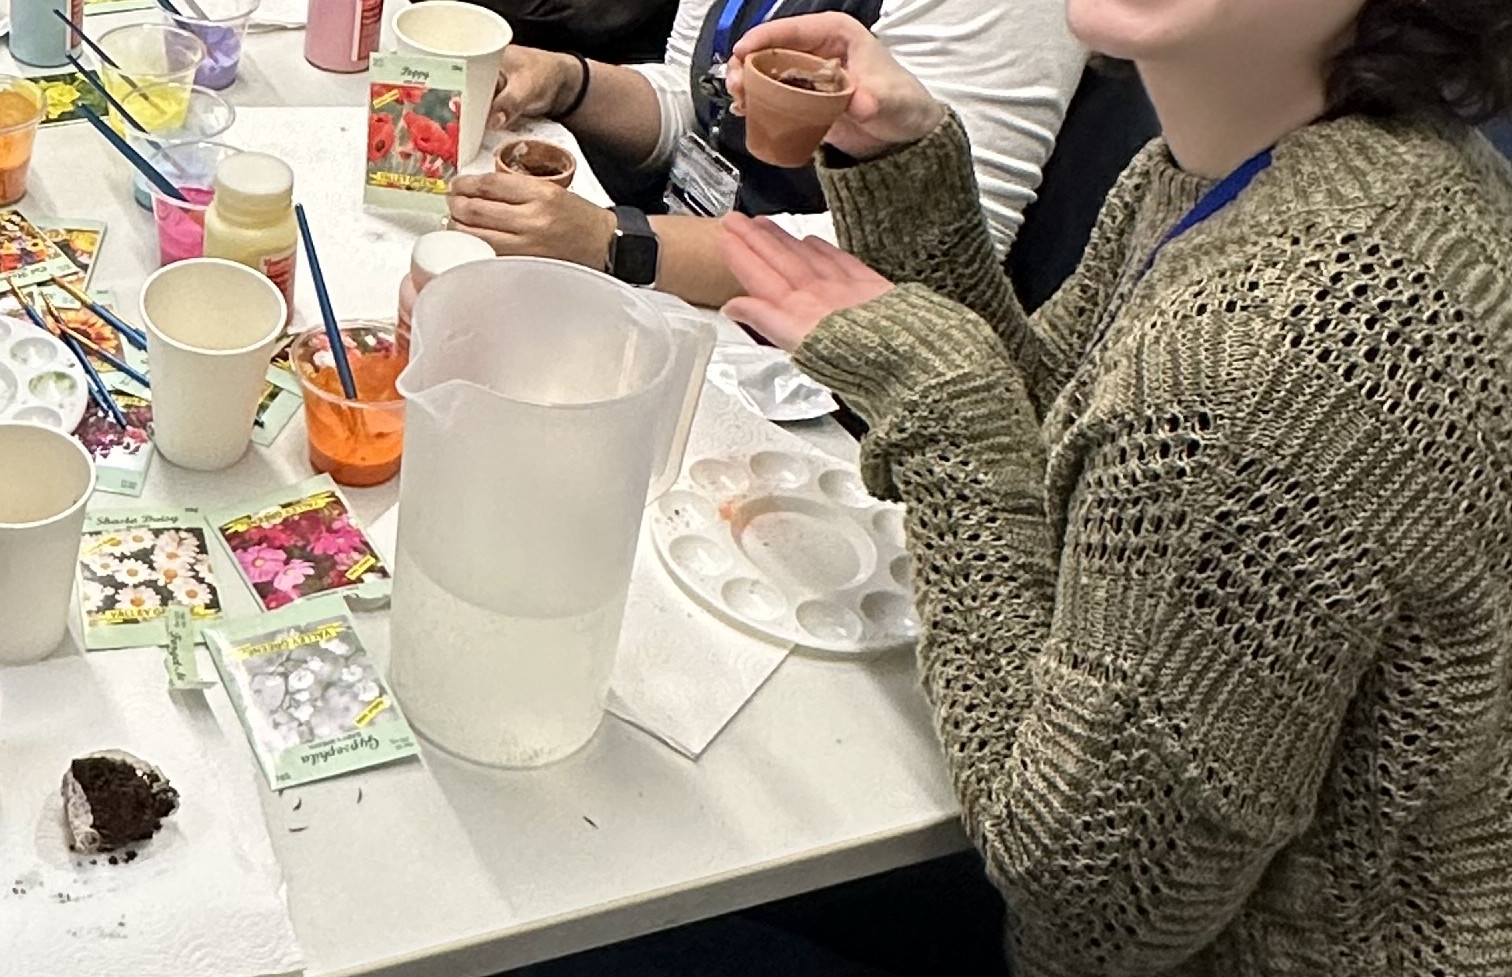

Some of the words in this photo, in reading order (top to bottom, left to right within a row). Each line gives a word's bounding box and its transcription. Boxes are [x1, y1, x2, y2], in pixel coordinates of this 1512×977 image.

[400, 66, 430, 80] Poppy
[96, 515, 137, 526] Shasta
[141, 515, 179, 524] Daisy
[110, 608, 150, 619] VALLEY
[293, 629, 332, 645] VALLEY
[301, 735, 380, 765] Gypsophila
